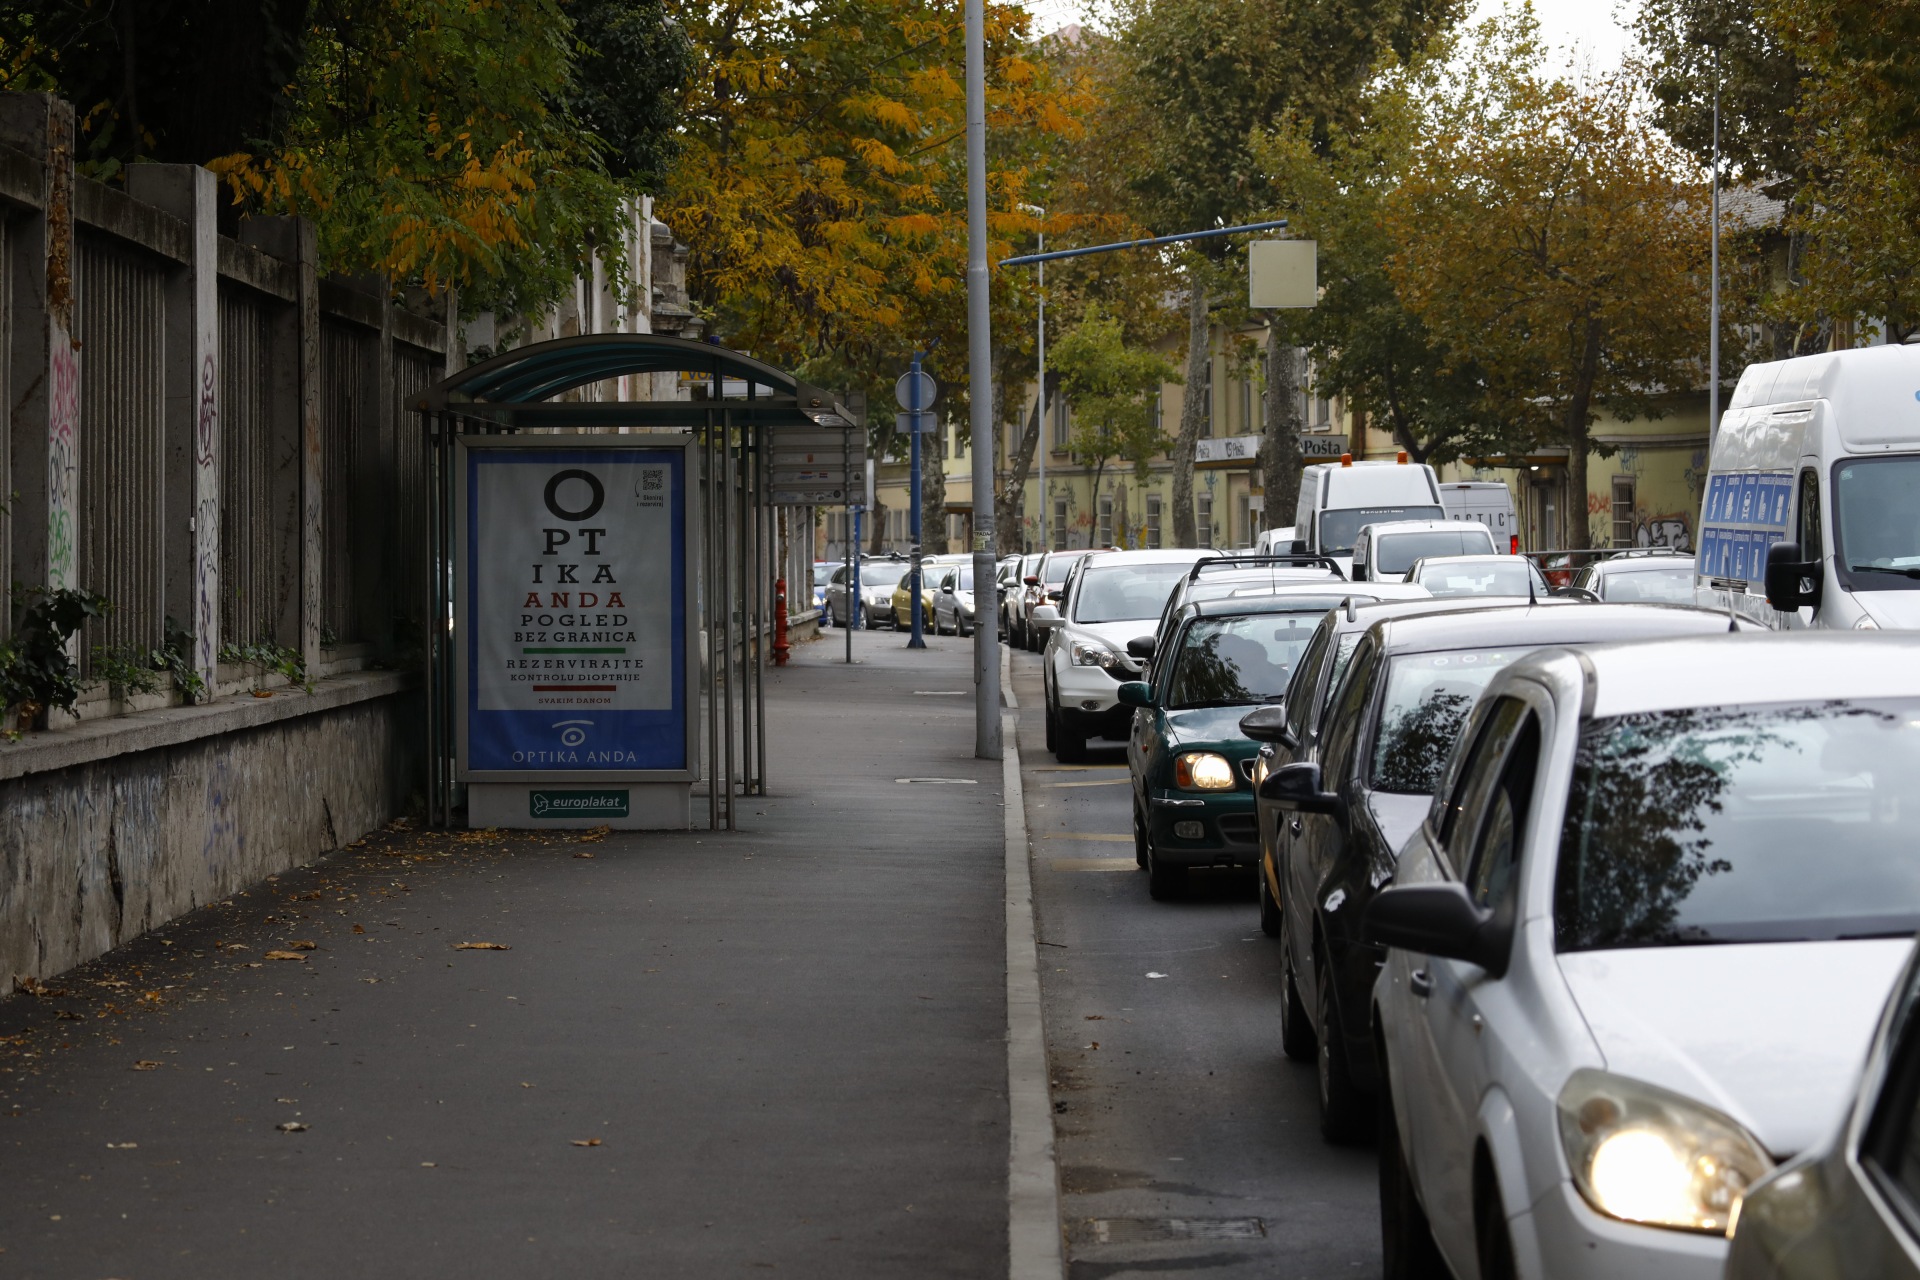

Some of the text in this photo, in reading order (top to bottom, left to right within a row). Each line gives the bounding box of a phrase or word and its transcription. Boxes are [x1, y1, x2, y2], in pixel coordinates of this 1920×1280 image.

[1304, 440, 1341, 455] Pošta
[544, 469, 604, 521] O
[532, 564, 616, 583] IKA
[523, 592, 625, 608] ANDA
[521, 614, 628, 626] POGLED
[514, 631, 637, 642] BEZ GRANICA
[506, 659, 643, 669] REZERVIRAJTE
[512, 751, 637, 762] OPTIKA ANDA
[553, 796, 620, 808] europlakat
